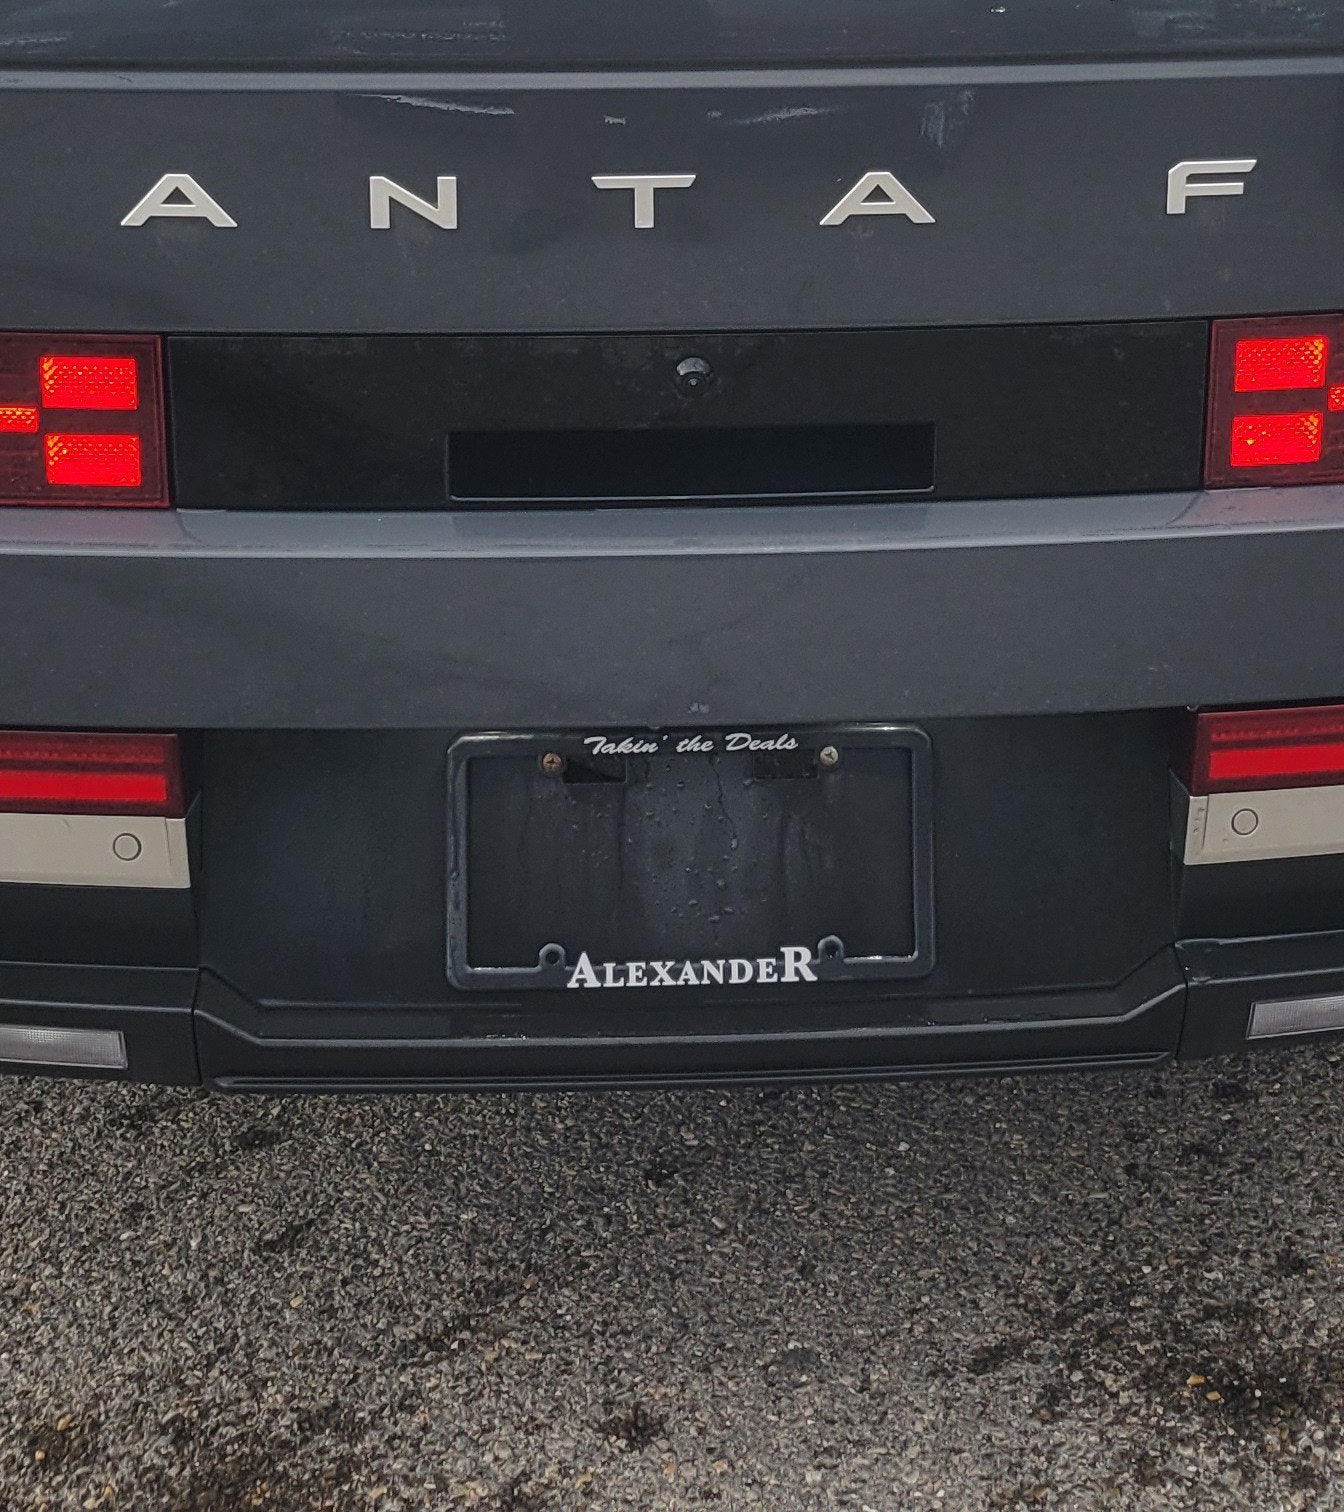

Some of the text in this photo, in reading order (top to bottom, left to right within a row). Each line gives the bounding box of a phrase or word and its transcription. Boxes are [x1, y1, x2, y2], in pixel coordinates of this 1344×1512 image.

[583, 732, 799, 756] Takin' the Deals
